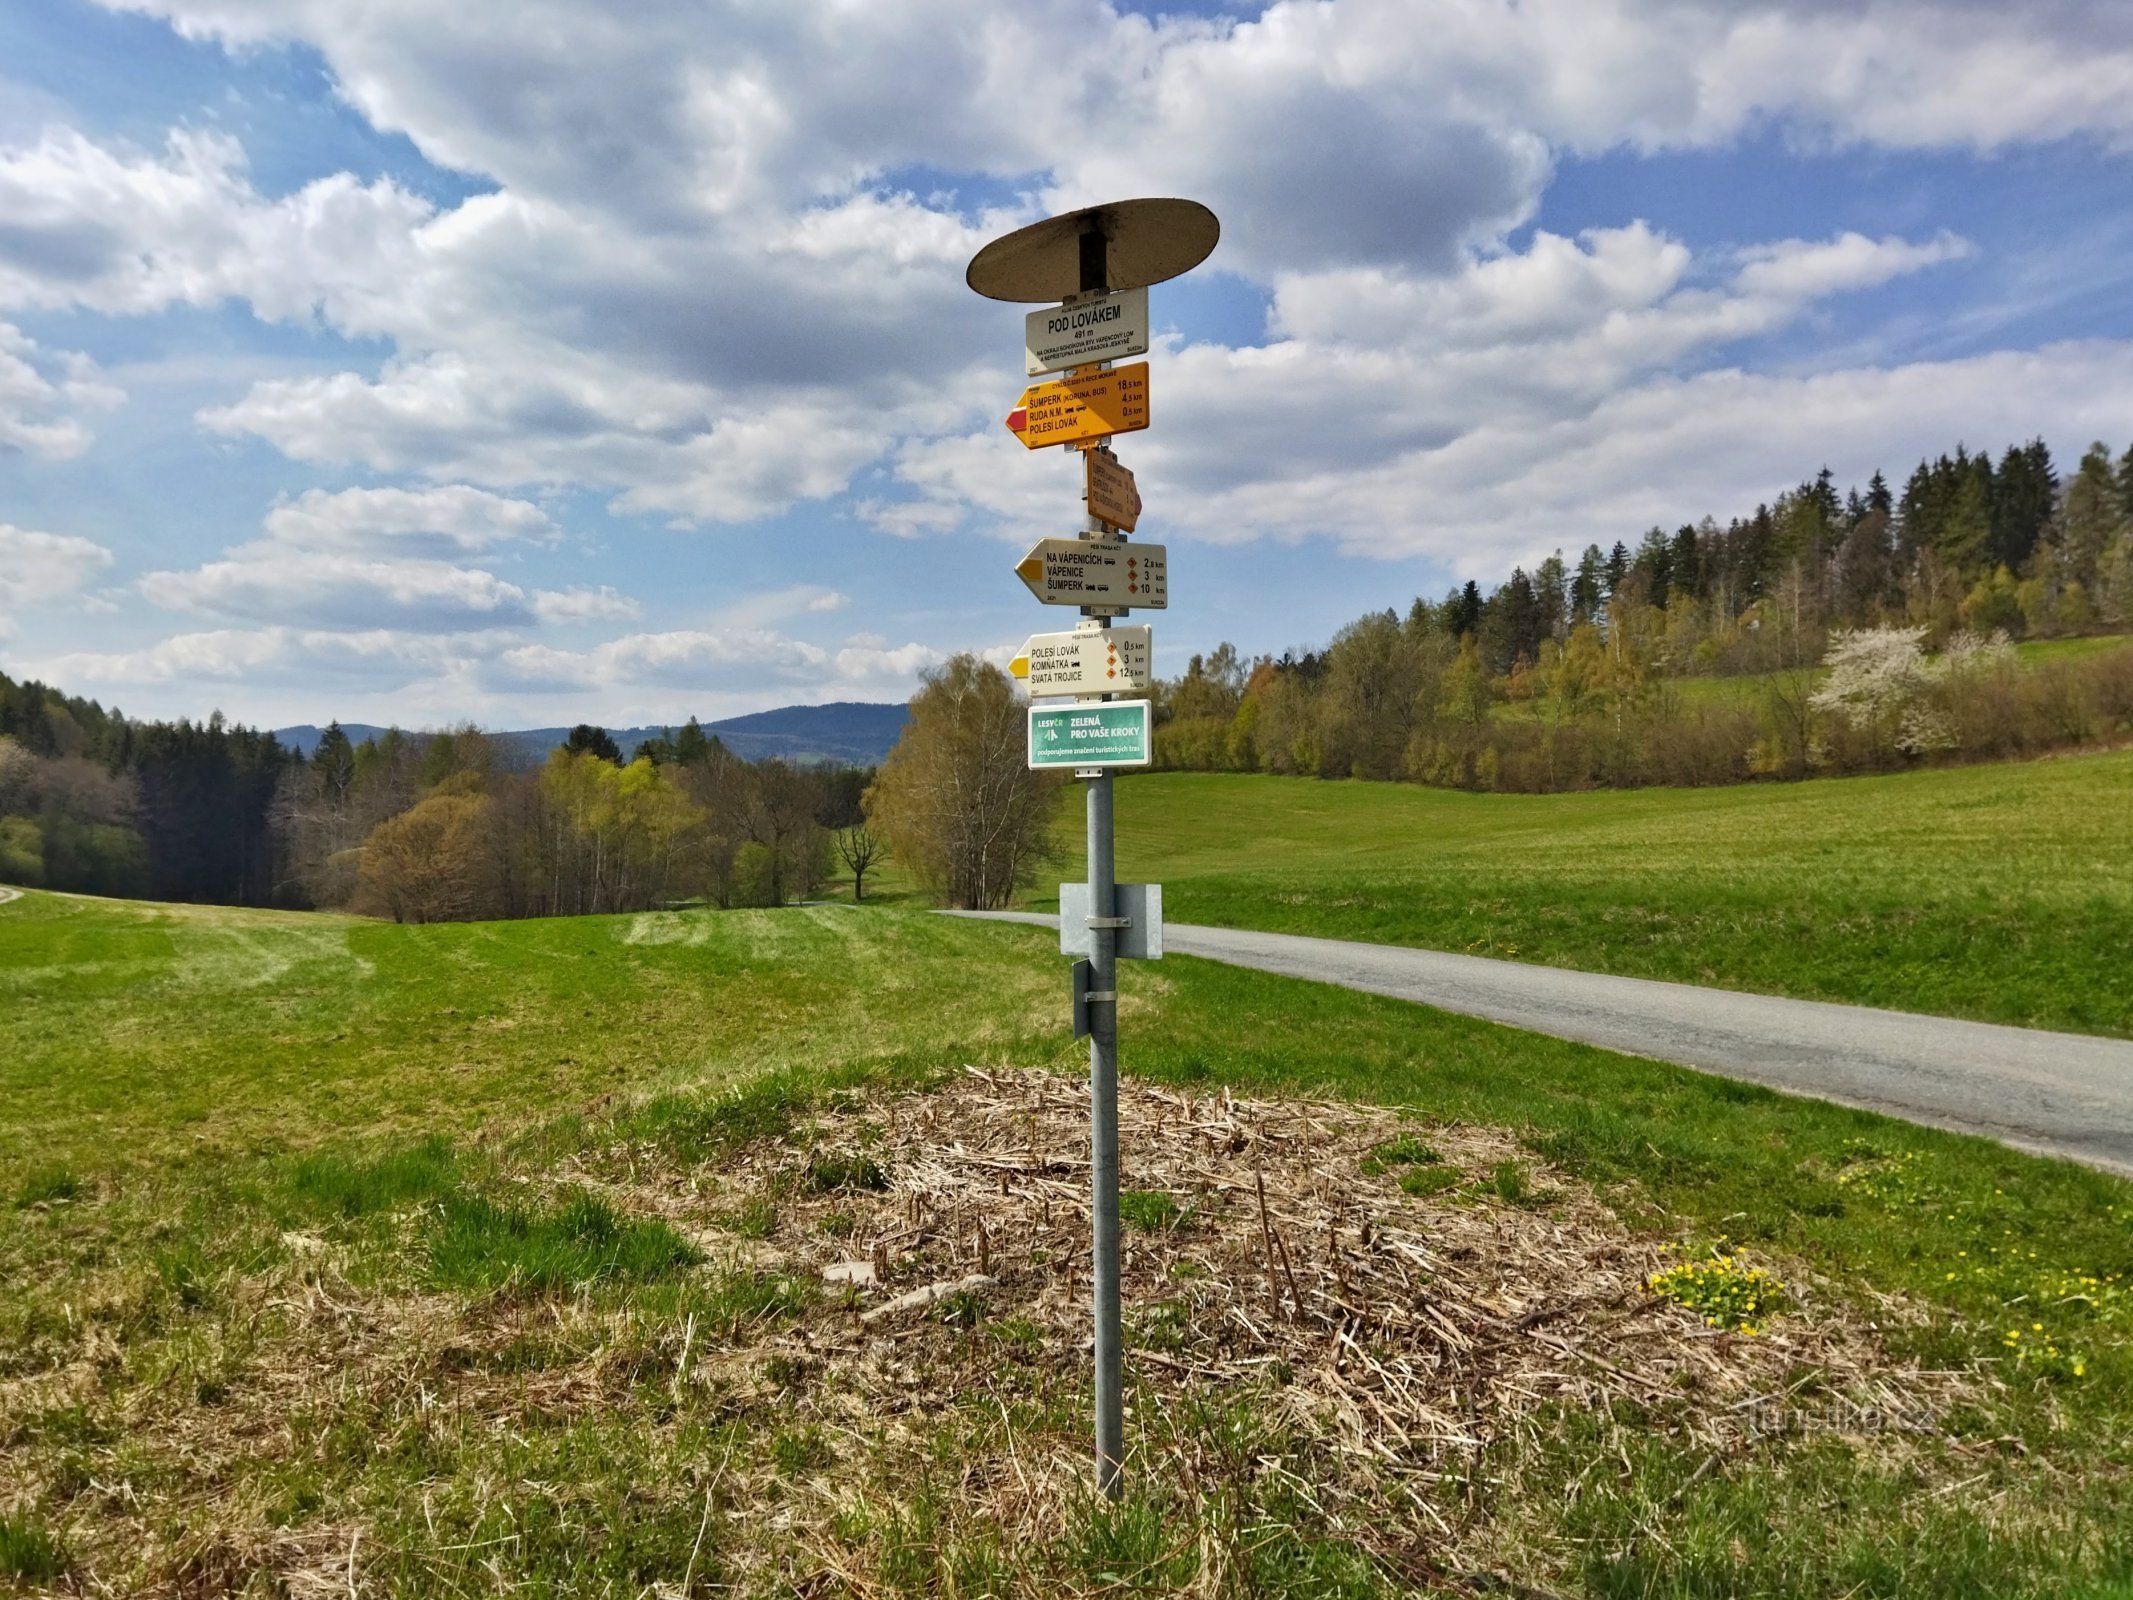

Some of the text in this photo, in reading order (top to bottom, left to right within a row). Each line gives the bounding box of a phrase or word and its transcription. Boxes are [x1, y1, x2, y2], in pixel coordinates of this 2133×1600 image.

[1048, 305, 1120, 334] POD LOVÁKEM
[1075, 330, 1086, 339] 491
[1096, 333, 1123, 344] VÁPENCOVÝ
[1118, 380, 1132, 391] 18,5
[1030, 393, 1062, 409] ŠUMPERK
[1092, 388, 1107, 396] BUS)
[1122, 394, 1132, 403] 4,5
[1030, 408, 1063, 421] RUDA N.M.
[1122, 407, 1142, 417] 0,5 km
[1030, 416, 1078, 435] POLESÍ LOVÁK
[1047, 551, 1102, 565] NA VÁPENICÍCH
[1047, 564, 1083, 577] VÁPENICE
[1144, 571, 1150, 581] 3
[1048, 577, 1084, 591] ŠUMPERK
[1141, 584, 1150, 593] 10
[1032, 644, 1079, 658] POLESÍ LOVÁK
[1124, 641, 1135, 650] 0,5
[1032, 658, 1068, 670] KOMŇÁTKA
[1124, 655, 1129, 664] 3
[1032, 670, 1082, 683] SVATÁ TROJICE
[1120, 668, 1134, 677] 12,5
[1071, 715, 1100, 727] ZELENÁ
[1071, 727, 1140, 739] PRO VAŠE KROKY
[1038, 749, 1073, 757] podporujeme
[1095, 745, 1128, 754] turistických
